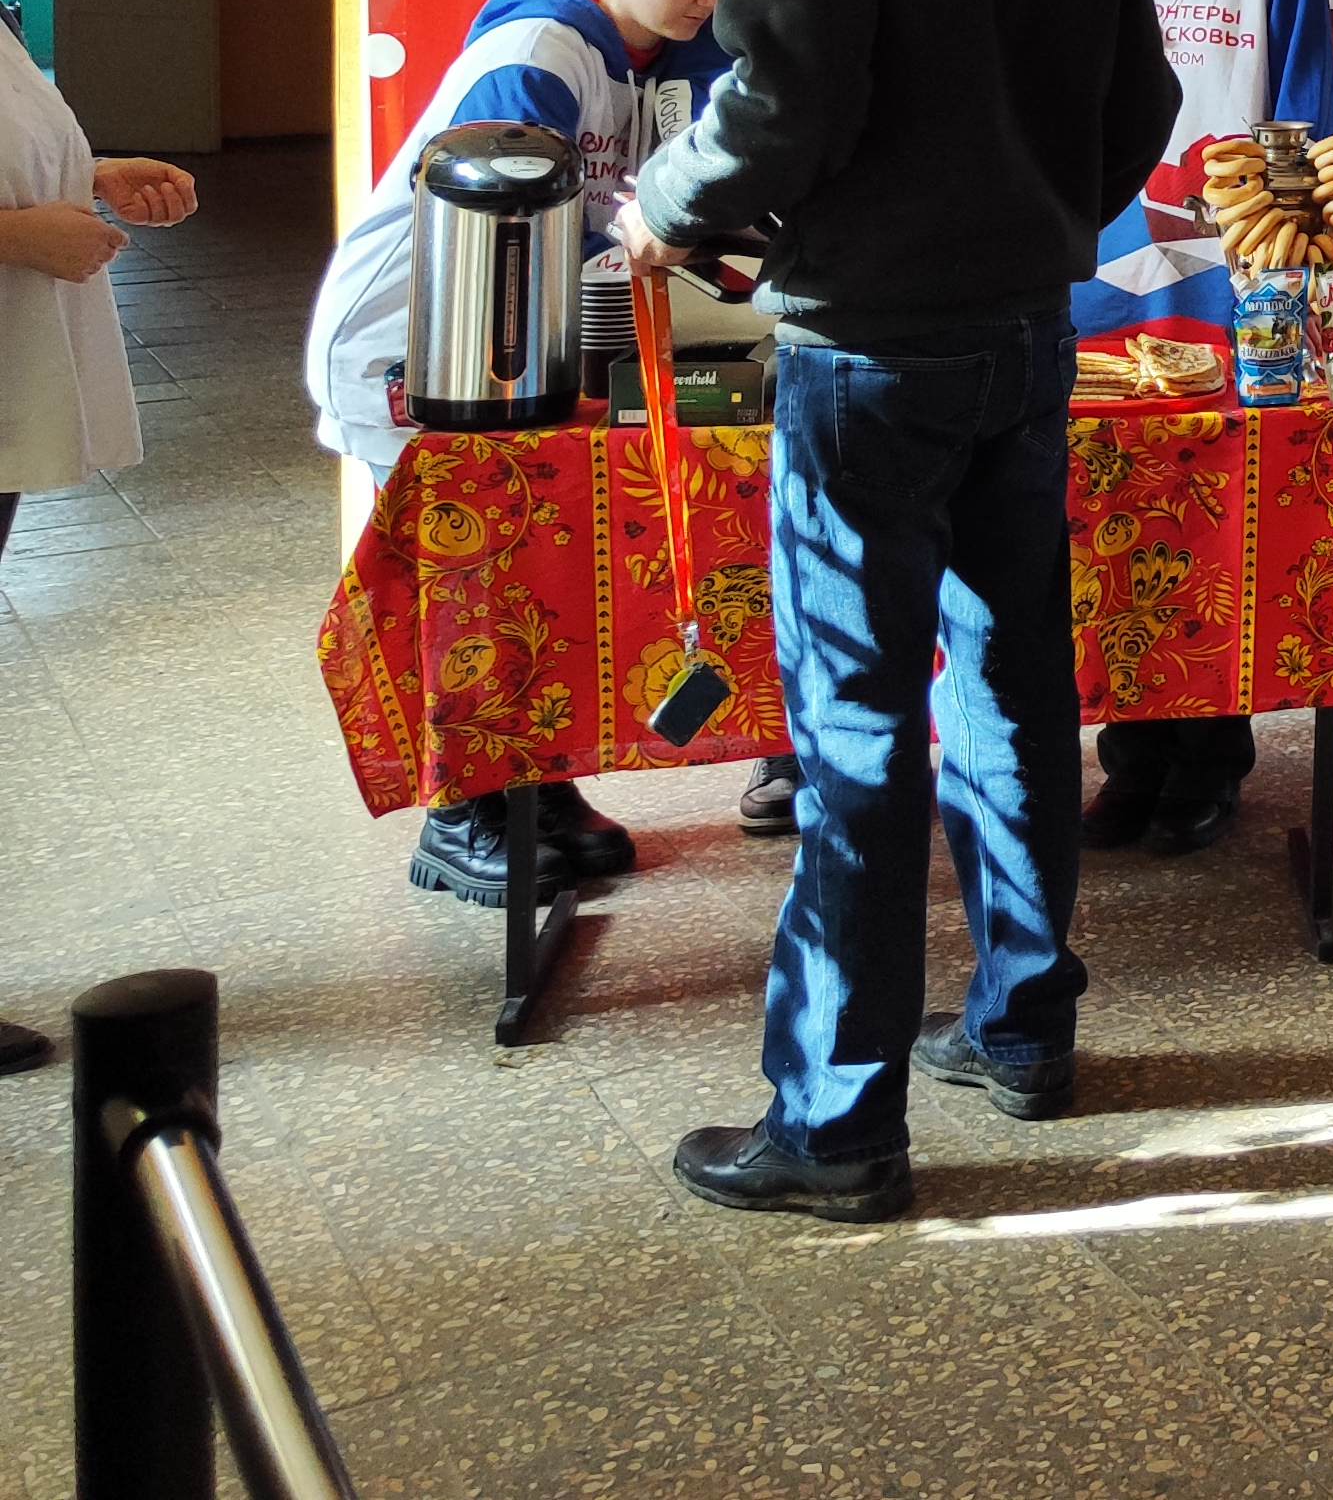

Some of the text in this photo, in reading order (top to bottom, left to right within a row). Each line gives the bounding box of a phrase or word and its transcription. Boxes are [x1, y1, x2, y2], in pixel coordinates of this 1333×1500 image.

[1154, 3, 1241, 25] ОНТЕРЫ
[1165, 26, 1256, 49] СКОВЬЯ
[1169, 51, 1204, 66] ДОМ
[673, 370, 718, 386] eenfield
